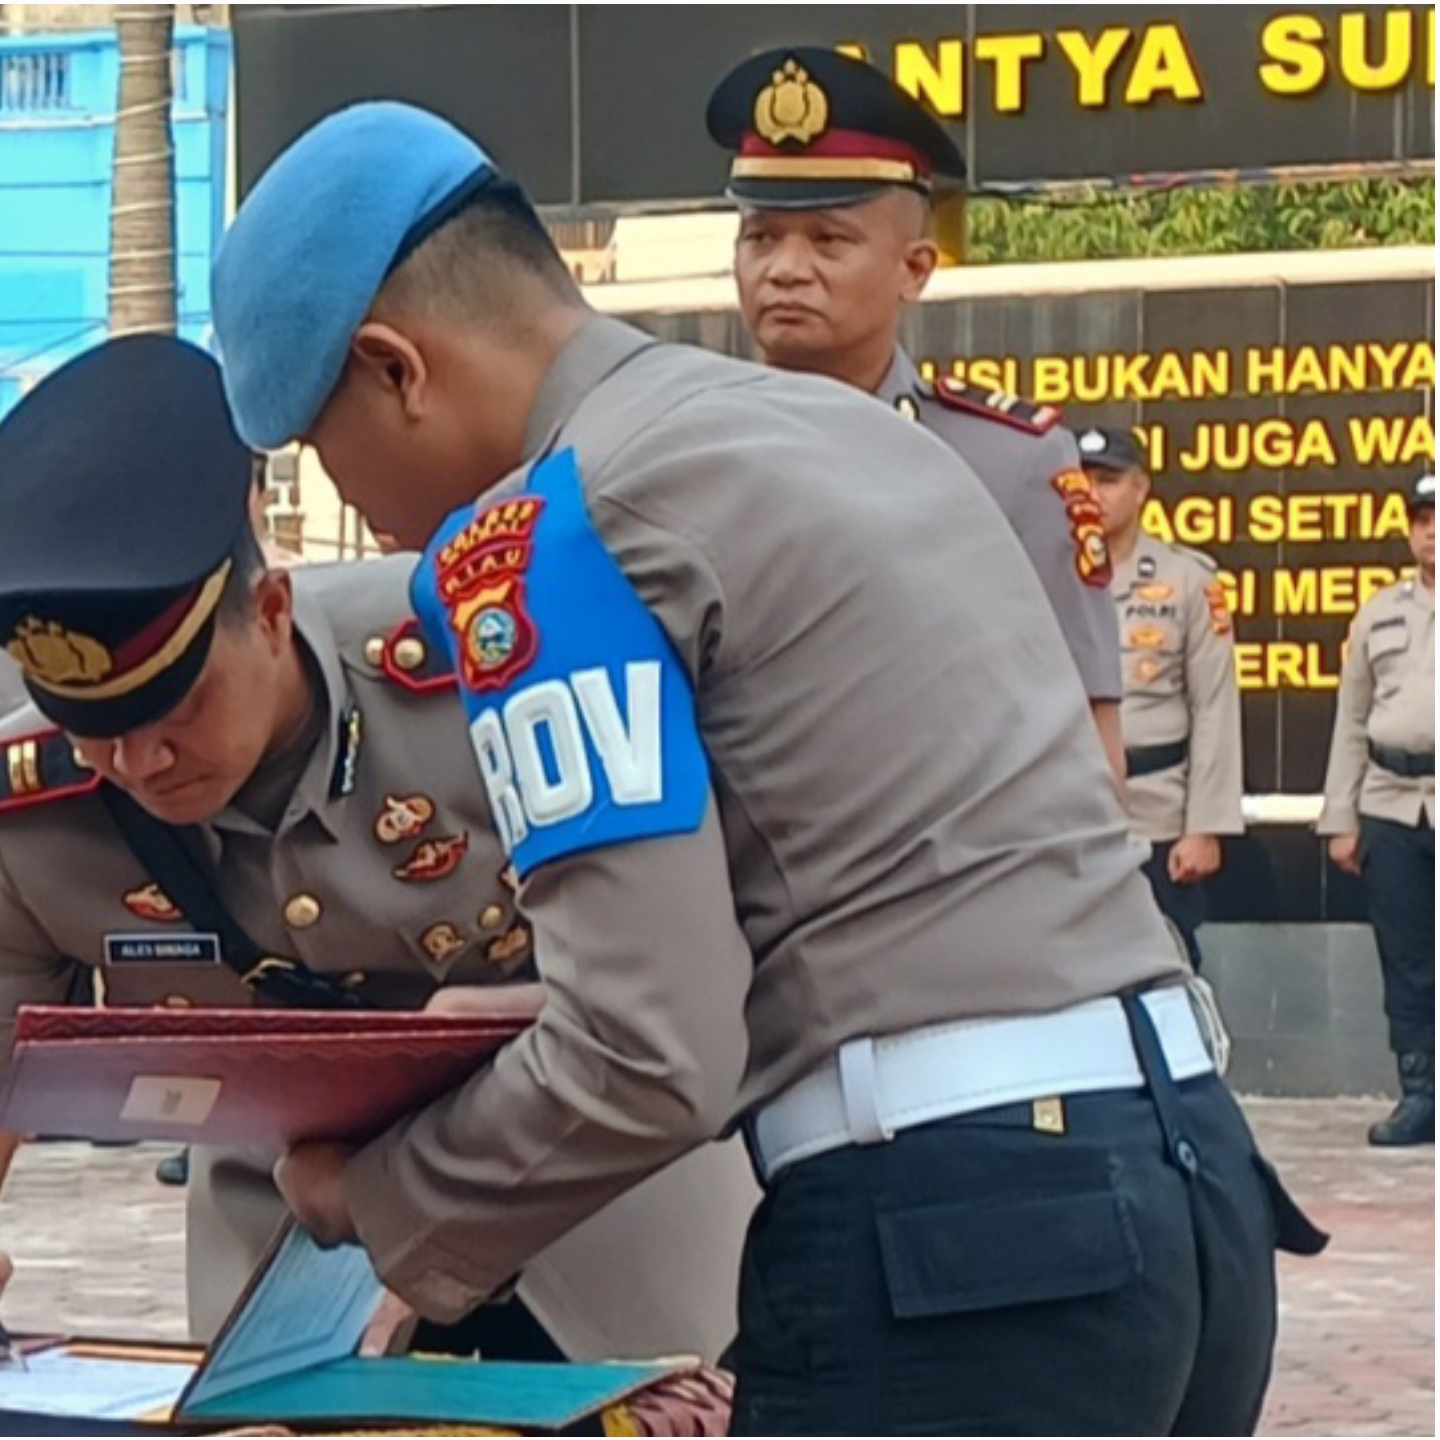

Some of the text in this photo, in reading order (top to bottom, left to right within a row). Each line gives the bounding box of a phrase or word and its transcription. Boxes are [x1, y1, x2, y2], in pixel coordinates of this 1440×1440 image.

[836, 9, 1435, 116] NTYA SU
[1033, 350, 1228, 402] BUKAN
[1248, 342, 1435, 395] HANYA
[1180, 420, 1336, 471] JUGA
[1248, 492, 1410, 543] SETIA
